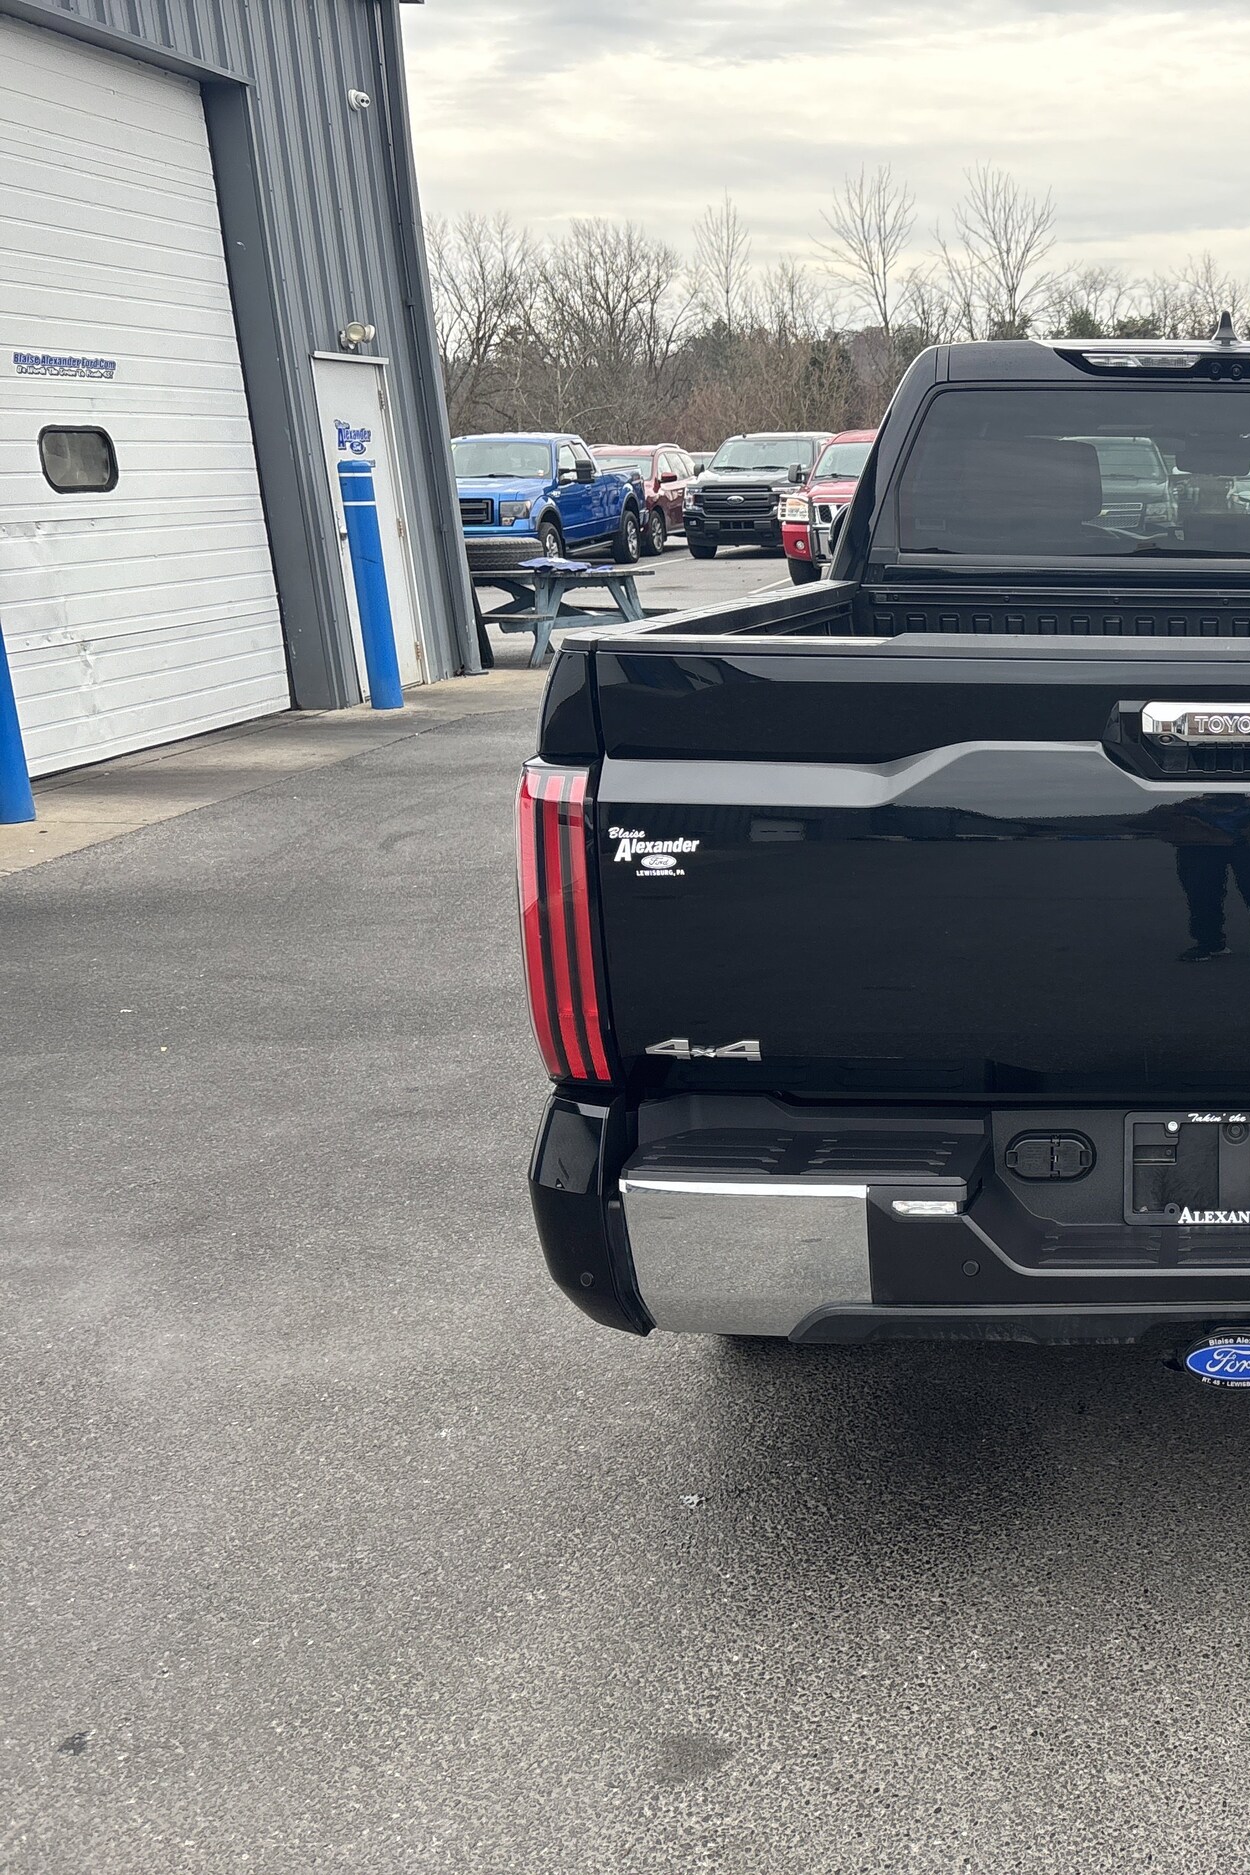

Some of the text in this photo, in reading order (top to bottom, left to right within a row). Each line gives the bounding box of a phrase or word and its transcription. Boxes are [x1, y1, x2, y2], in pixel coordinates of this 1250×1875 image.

[13, 352, 40, 366] Blaise
[40, 354, 82, 368] Alexander
[608, 826, 646, 839] Blaise
[613, 837, 700, 862] Alexander
[635, 869, 676, 877] LEWISBURG,
[1187, 1113, 1226, 1122] Takin'
[1228, 1113, 1247, 1122] the
[1208, 1337, 1234, 1347] Blaise
